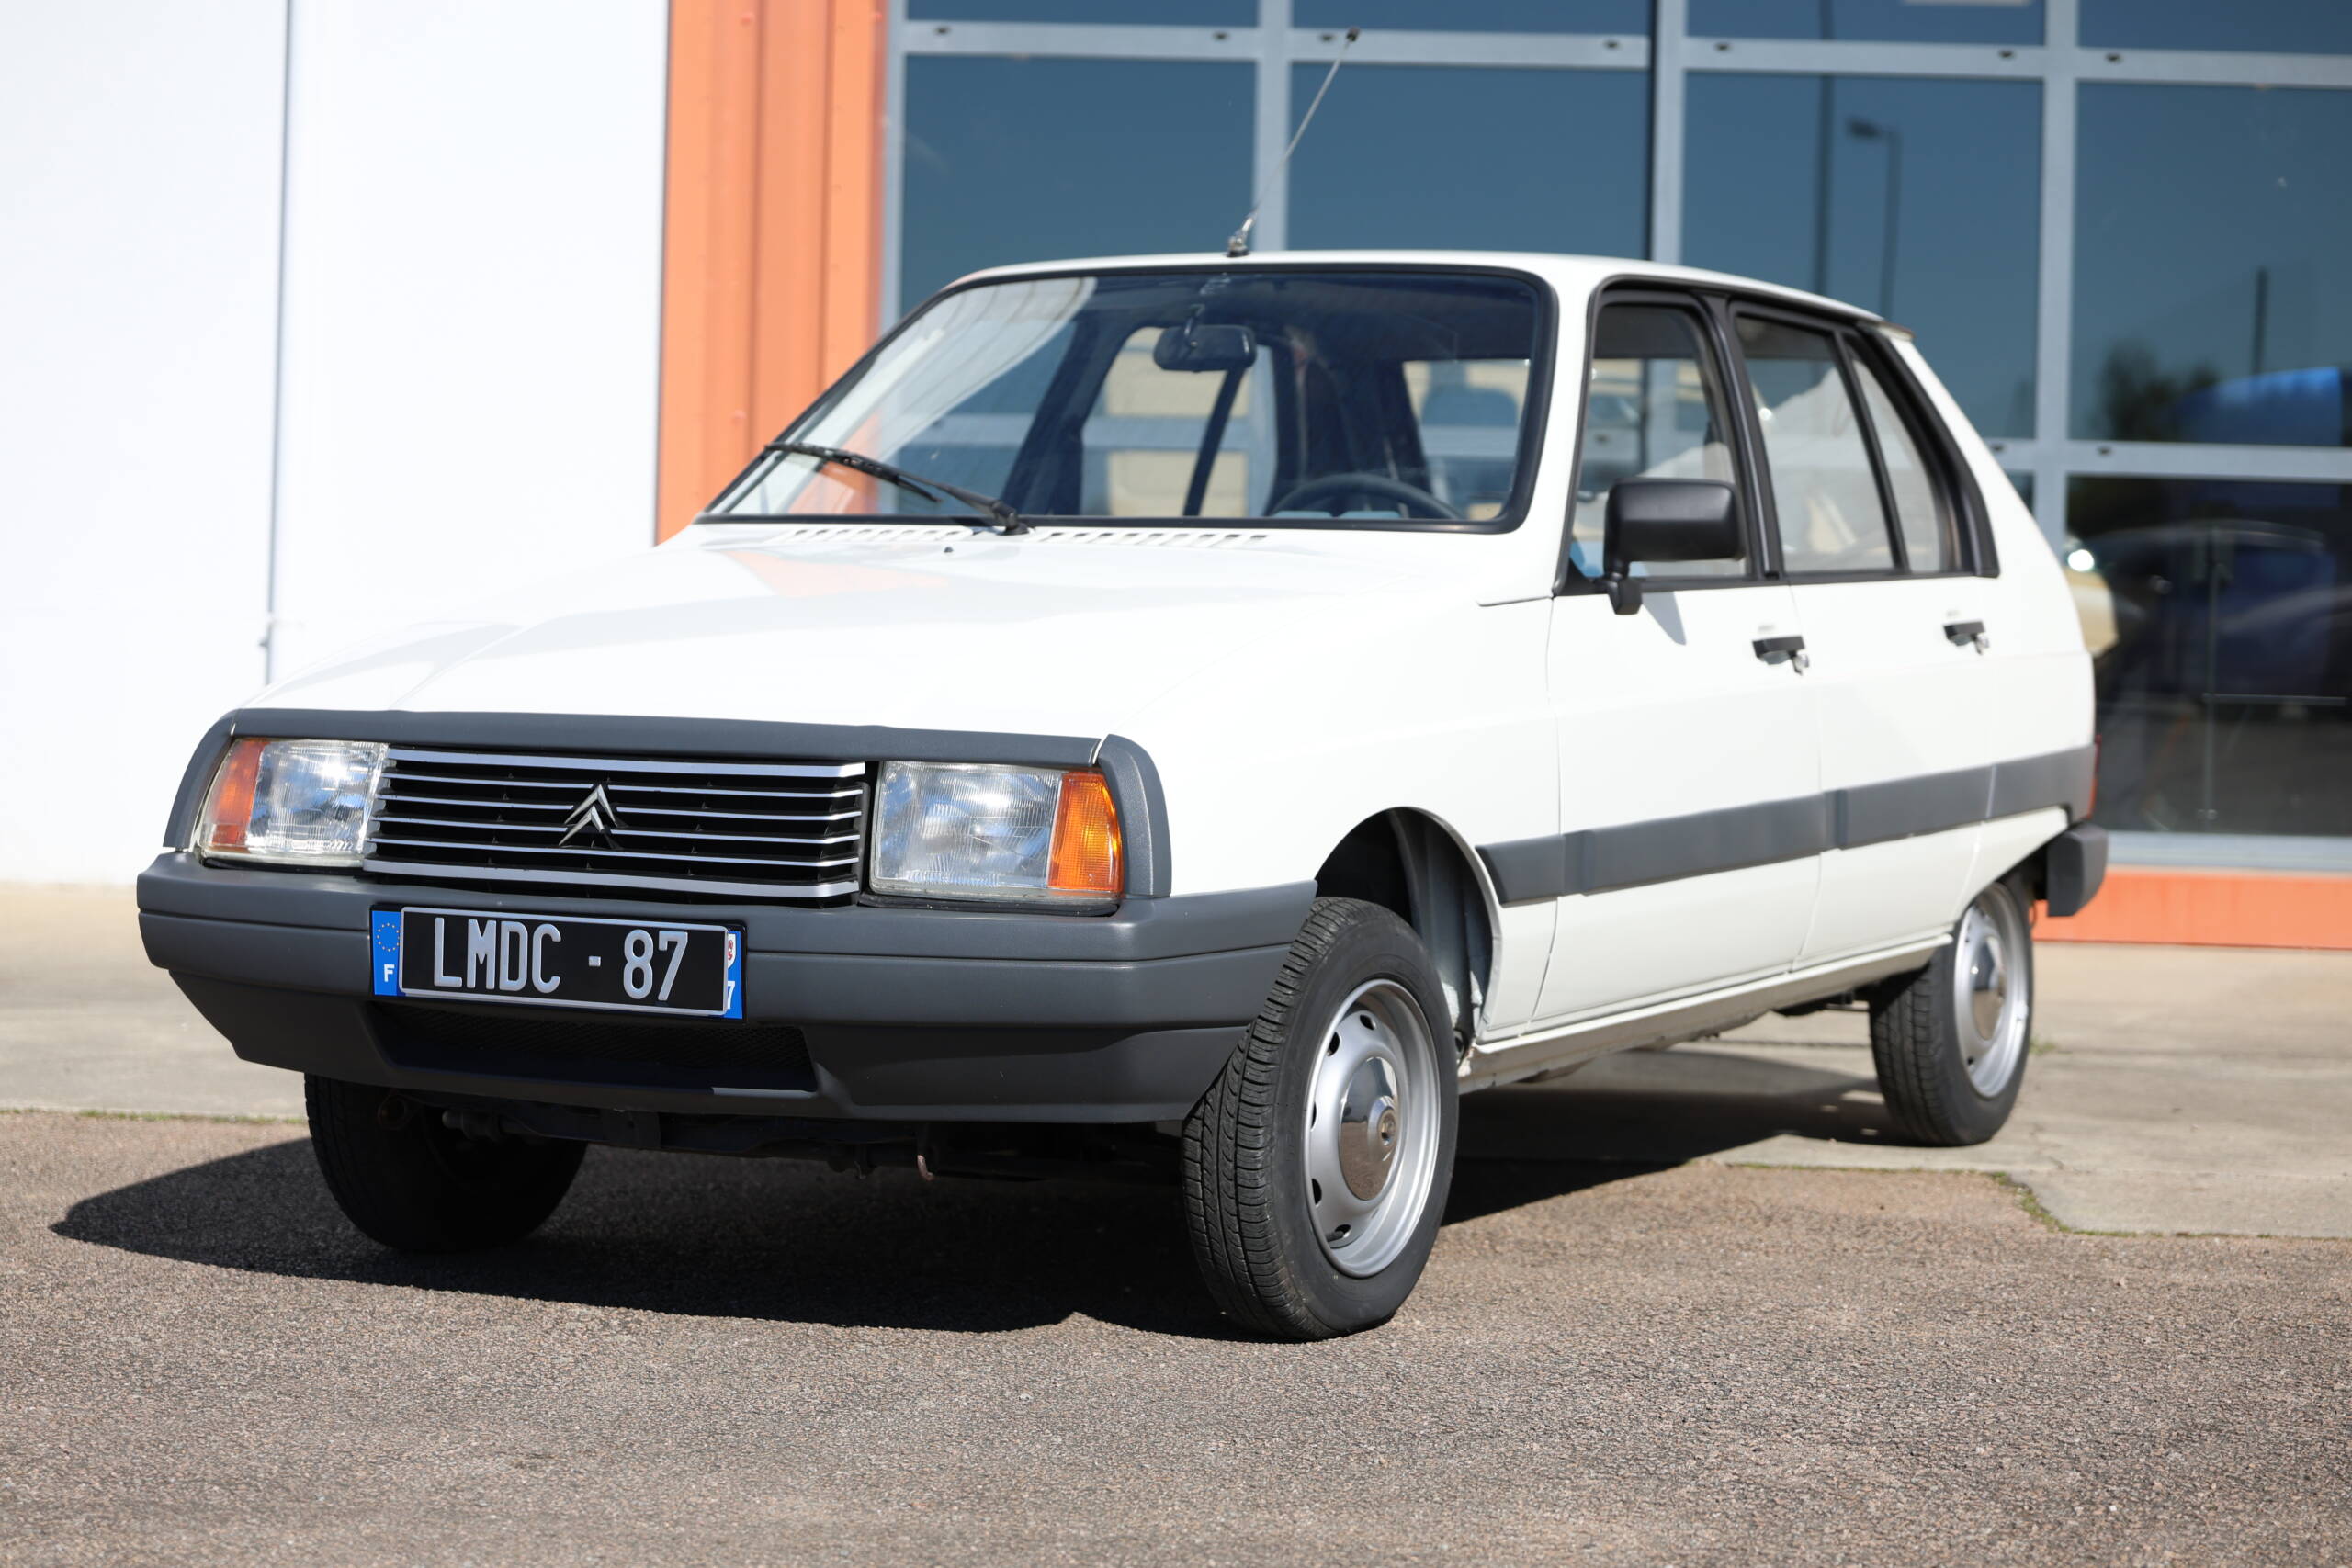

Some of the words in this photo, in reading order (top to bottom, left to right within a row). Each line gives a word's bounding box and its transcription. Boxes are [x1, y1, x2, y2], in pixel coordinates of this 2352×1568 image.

[383, 964, 395, 982] F
[434, 917, 561, 993] LMDC
[622, 929, 689, 1002] 87
